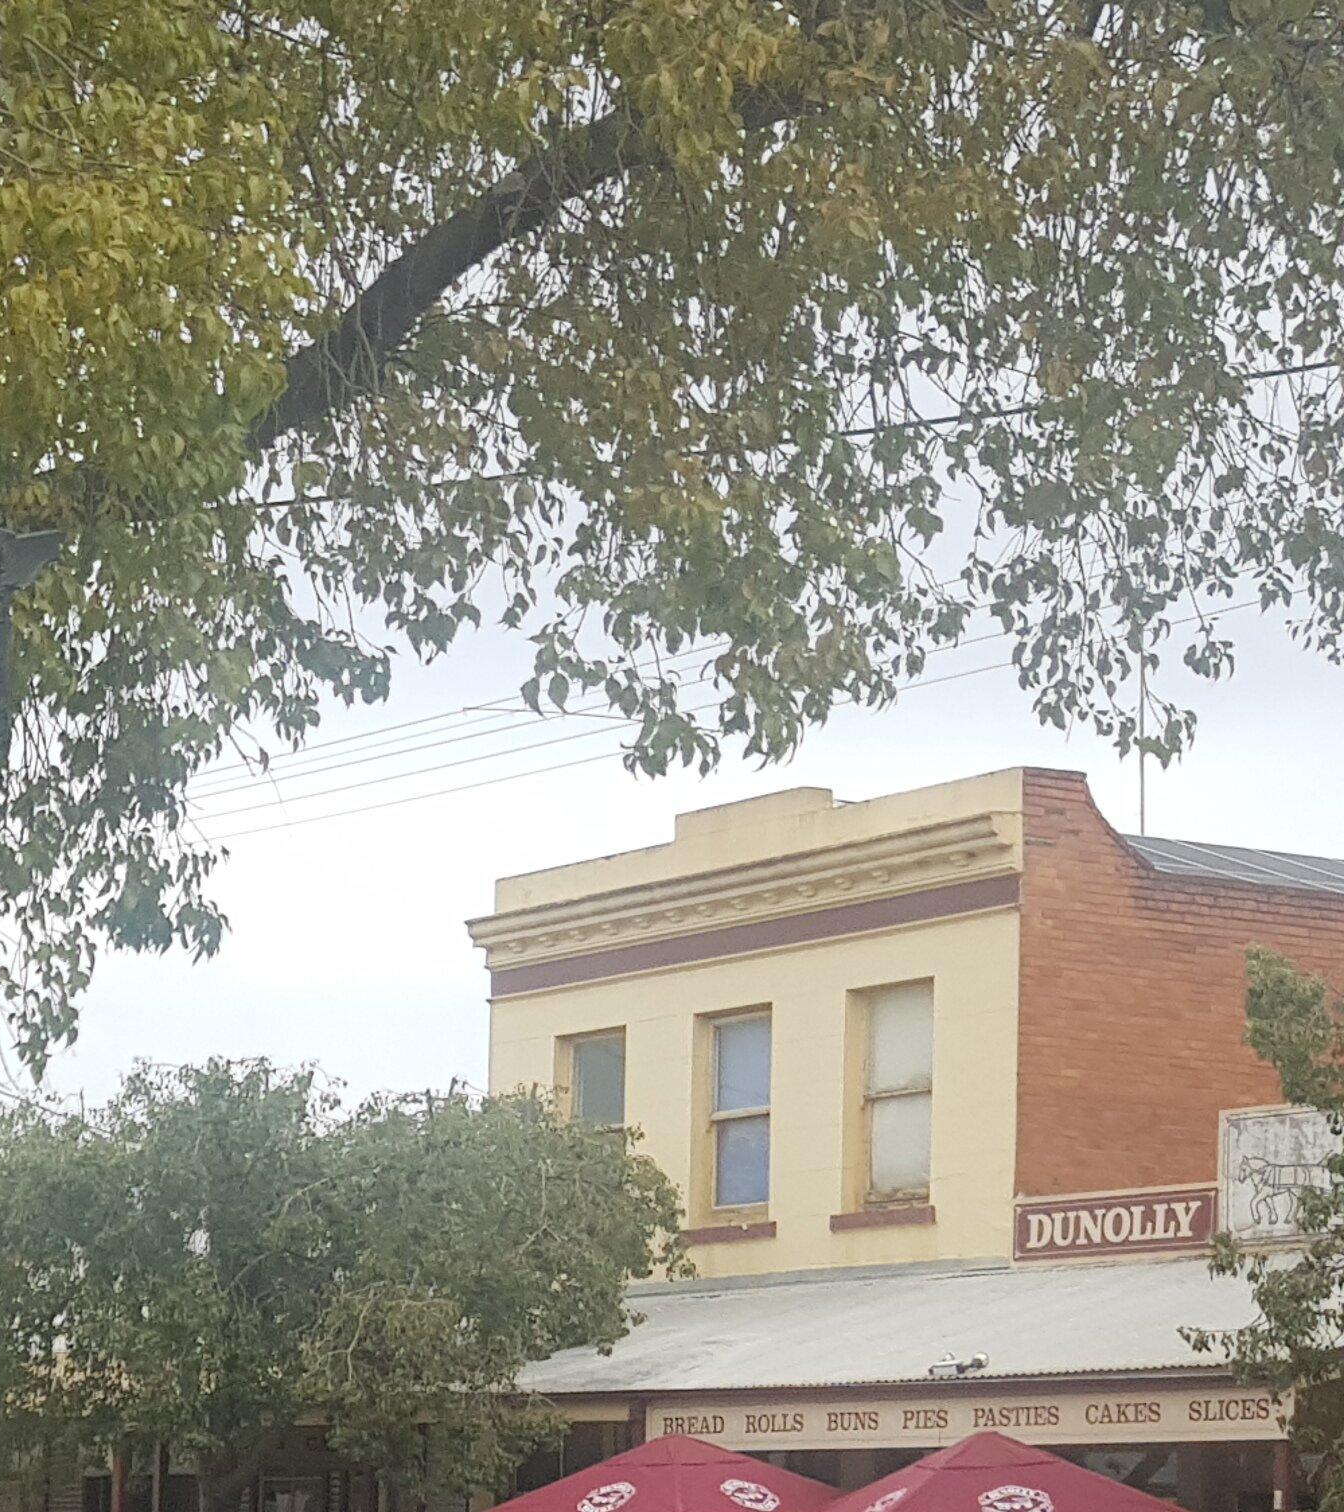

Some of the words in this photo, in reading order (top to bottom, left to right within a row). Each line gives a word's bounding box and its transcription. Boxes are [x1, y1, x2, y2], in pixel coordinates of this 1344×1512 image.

[1025, 1200, 1203, 1249] DUNOLLY
[662, 1415, 725, 1436] BREAD
[744, 1412, 805, 1434] ROLLS
[826, 1411, 880, 1432] BUNS
[901, 1409, 949, 1430] PIES
[973, 1405, 1061, 1428] PASTIES
[1084, 1402, 1162, 1425] CAKES
[1188, 1398, 1271, 1422] SLICES
